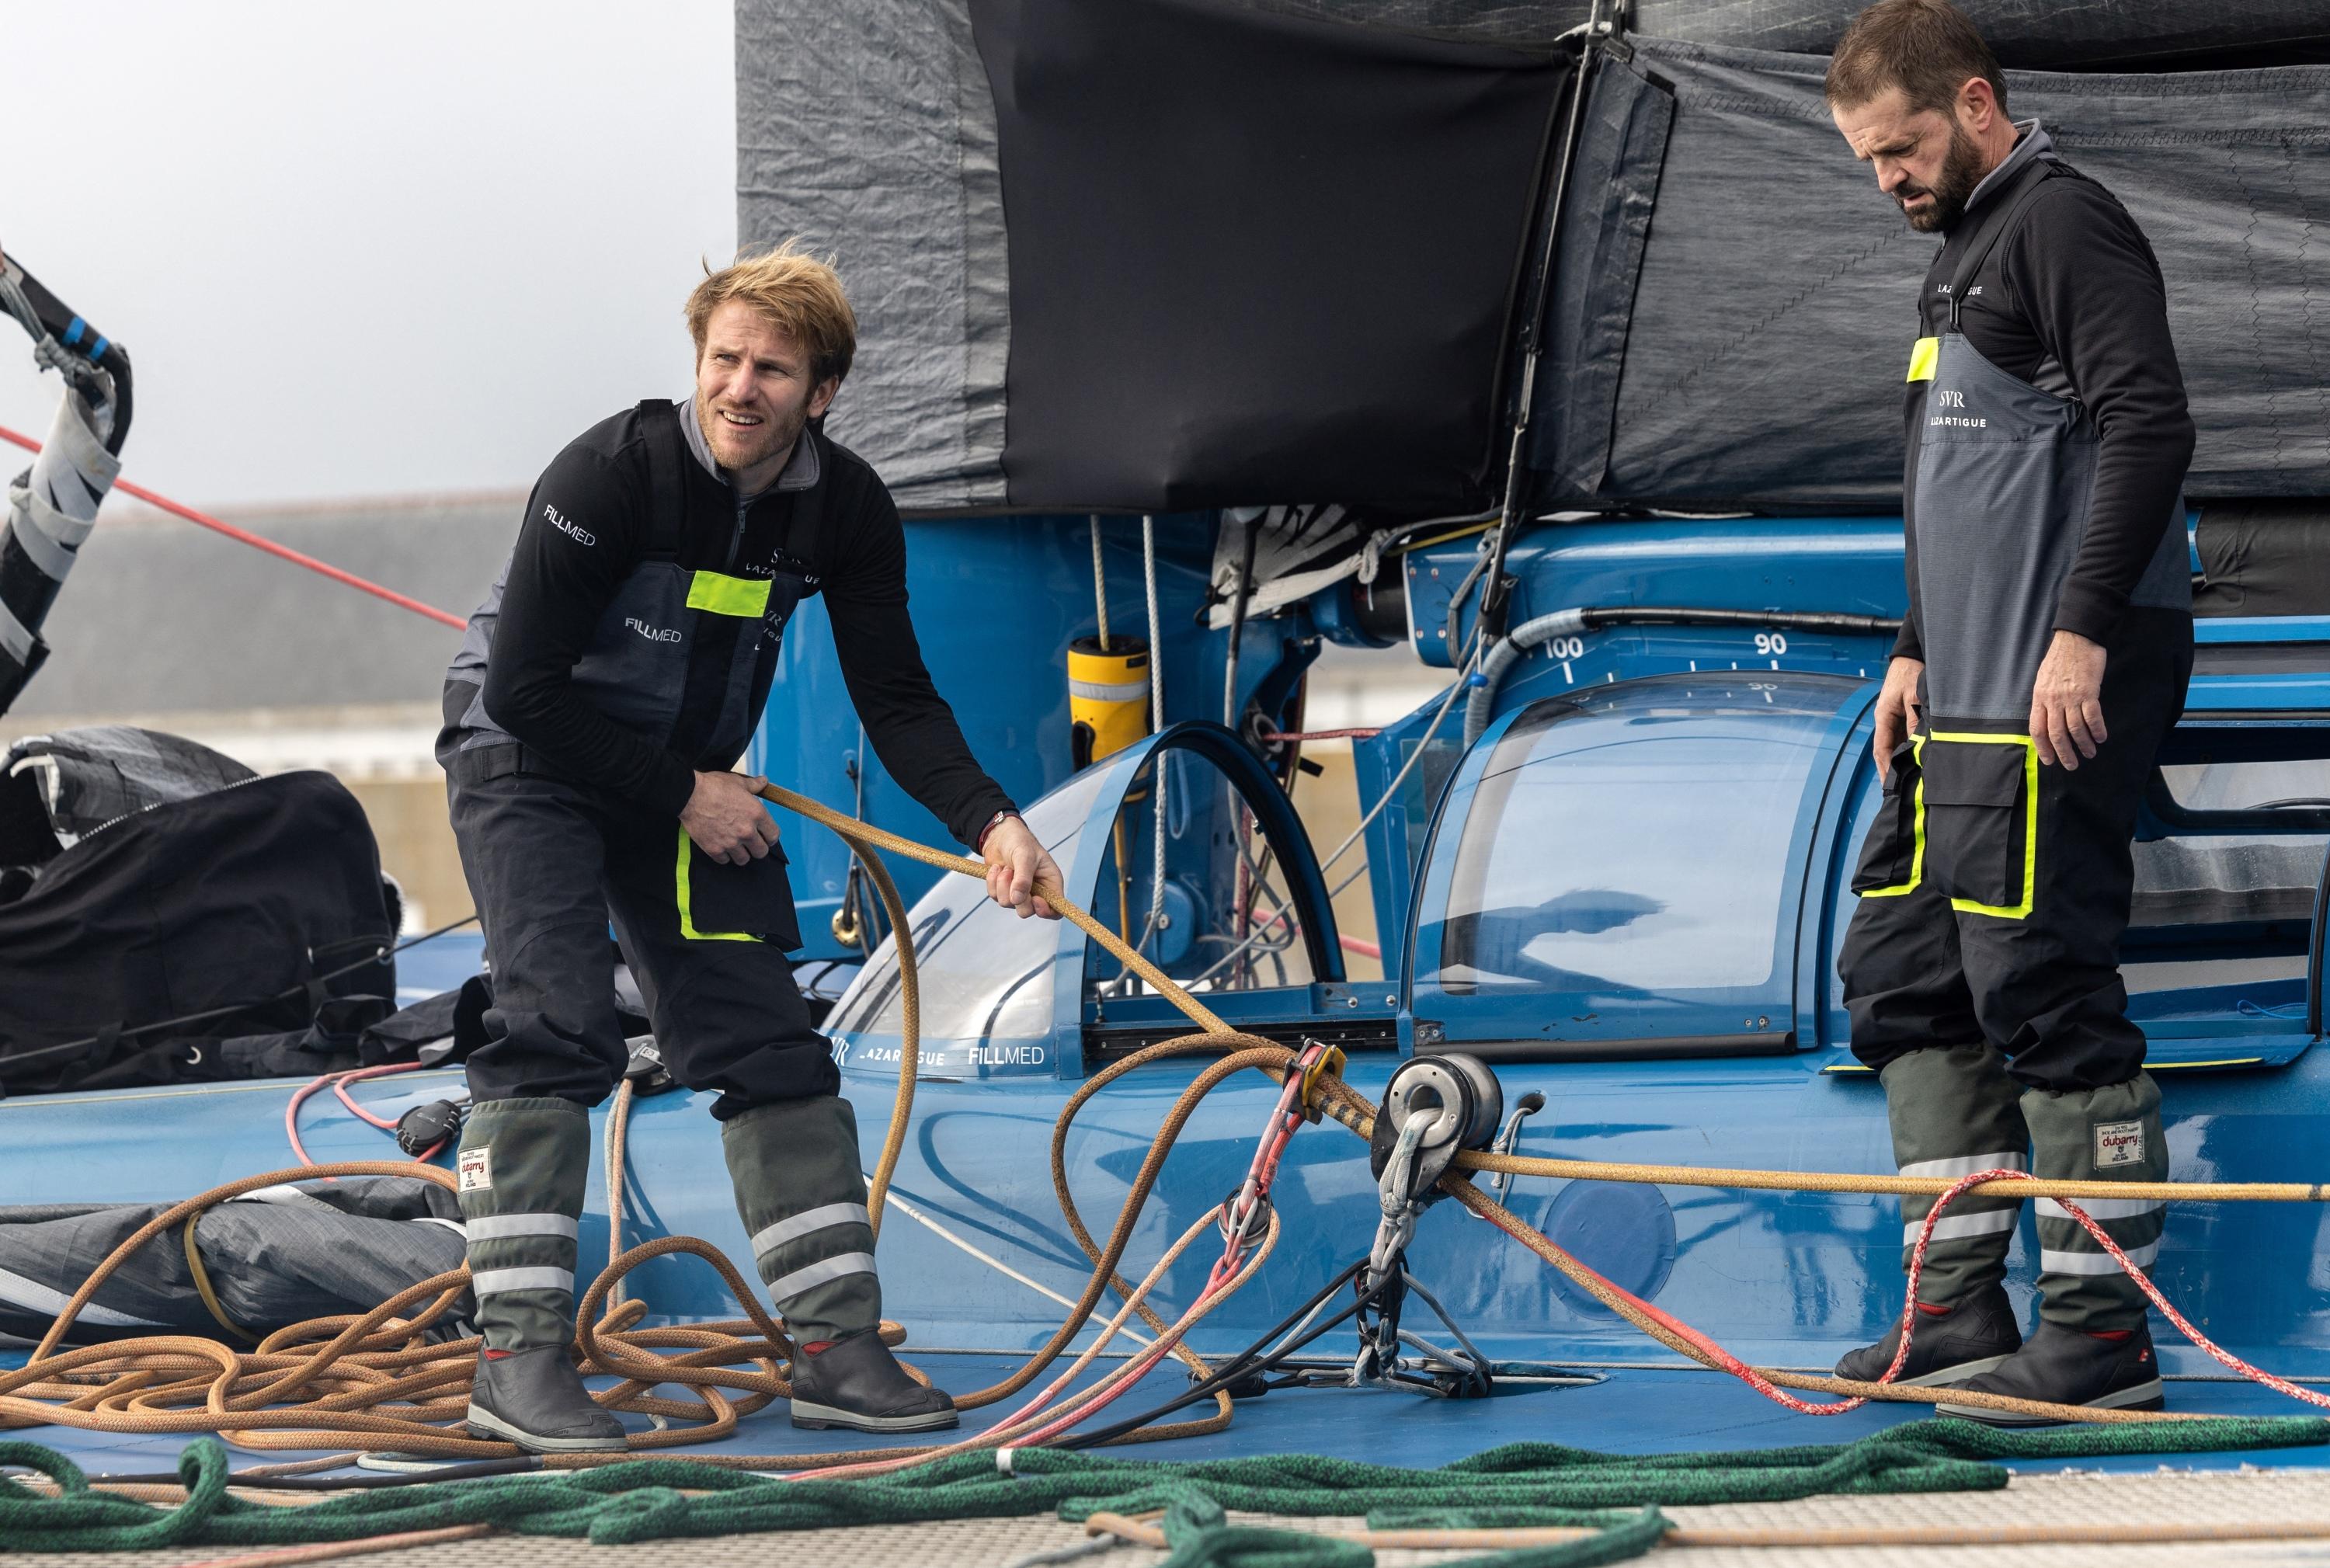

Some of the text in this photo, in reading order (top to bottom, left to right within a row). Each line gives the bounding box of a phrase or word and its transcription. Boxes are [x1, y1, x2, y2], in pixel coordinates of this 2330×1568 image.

[1937, 283, 1983, 296] LAZGUE
[1939, 390, 1966, 409] SVR
[1930, 416, 1987, 428] LAZARTIGUE
[544, 504, 596, 546] FILLMED
[746, 562, 821, 585] LAZAUE
[624, 617, 682, 643] FILLMED
[1542, 637, 1584, 659] 100
[1754, 633, 1788, 655] 90
[969, 1047, 1045, 1065] FILLMED
[2102, 1135, 2138, 1147] dubarry
